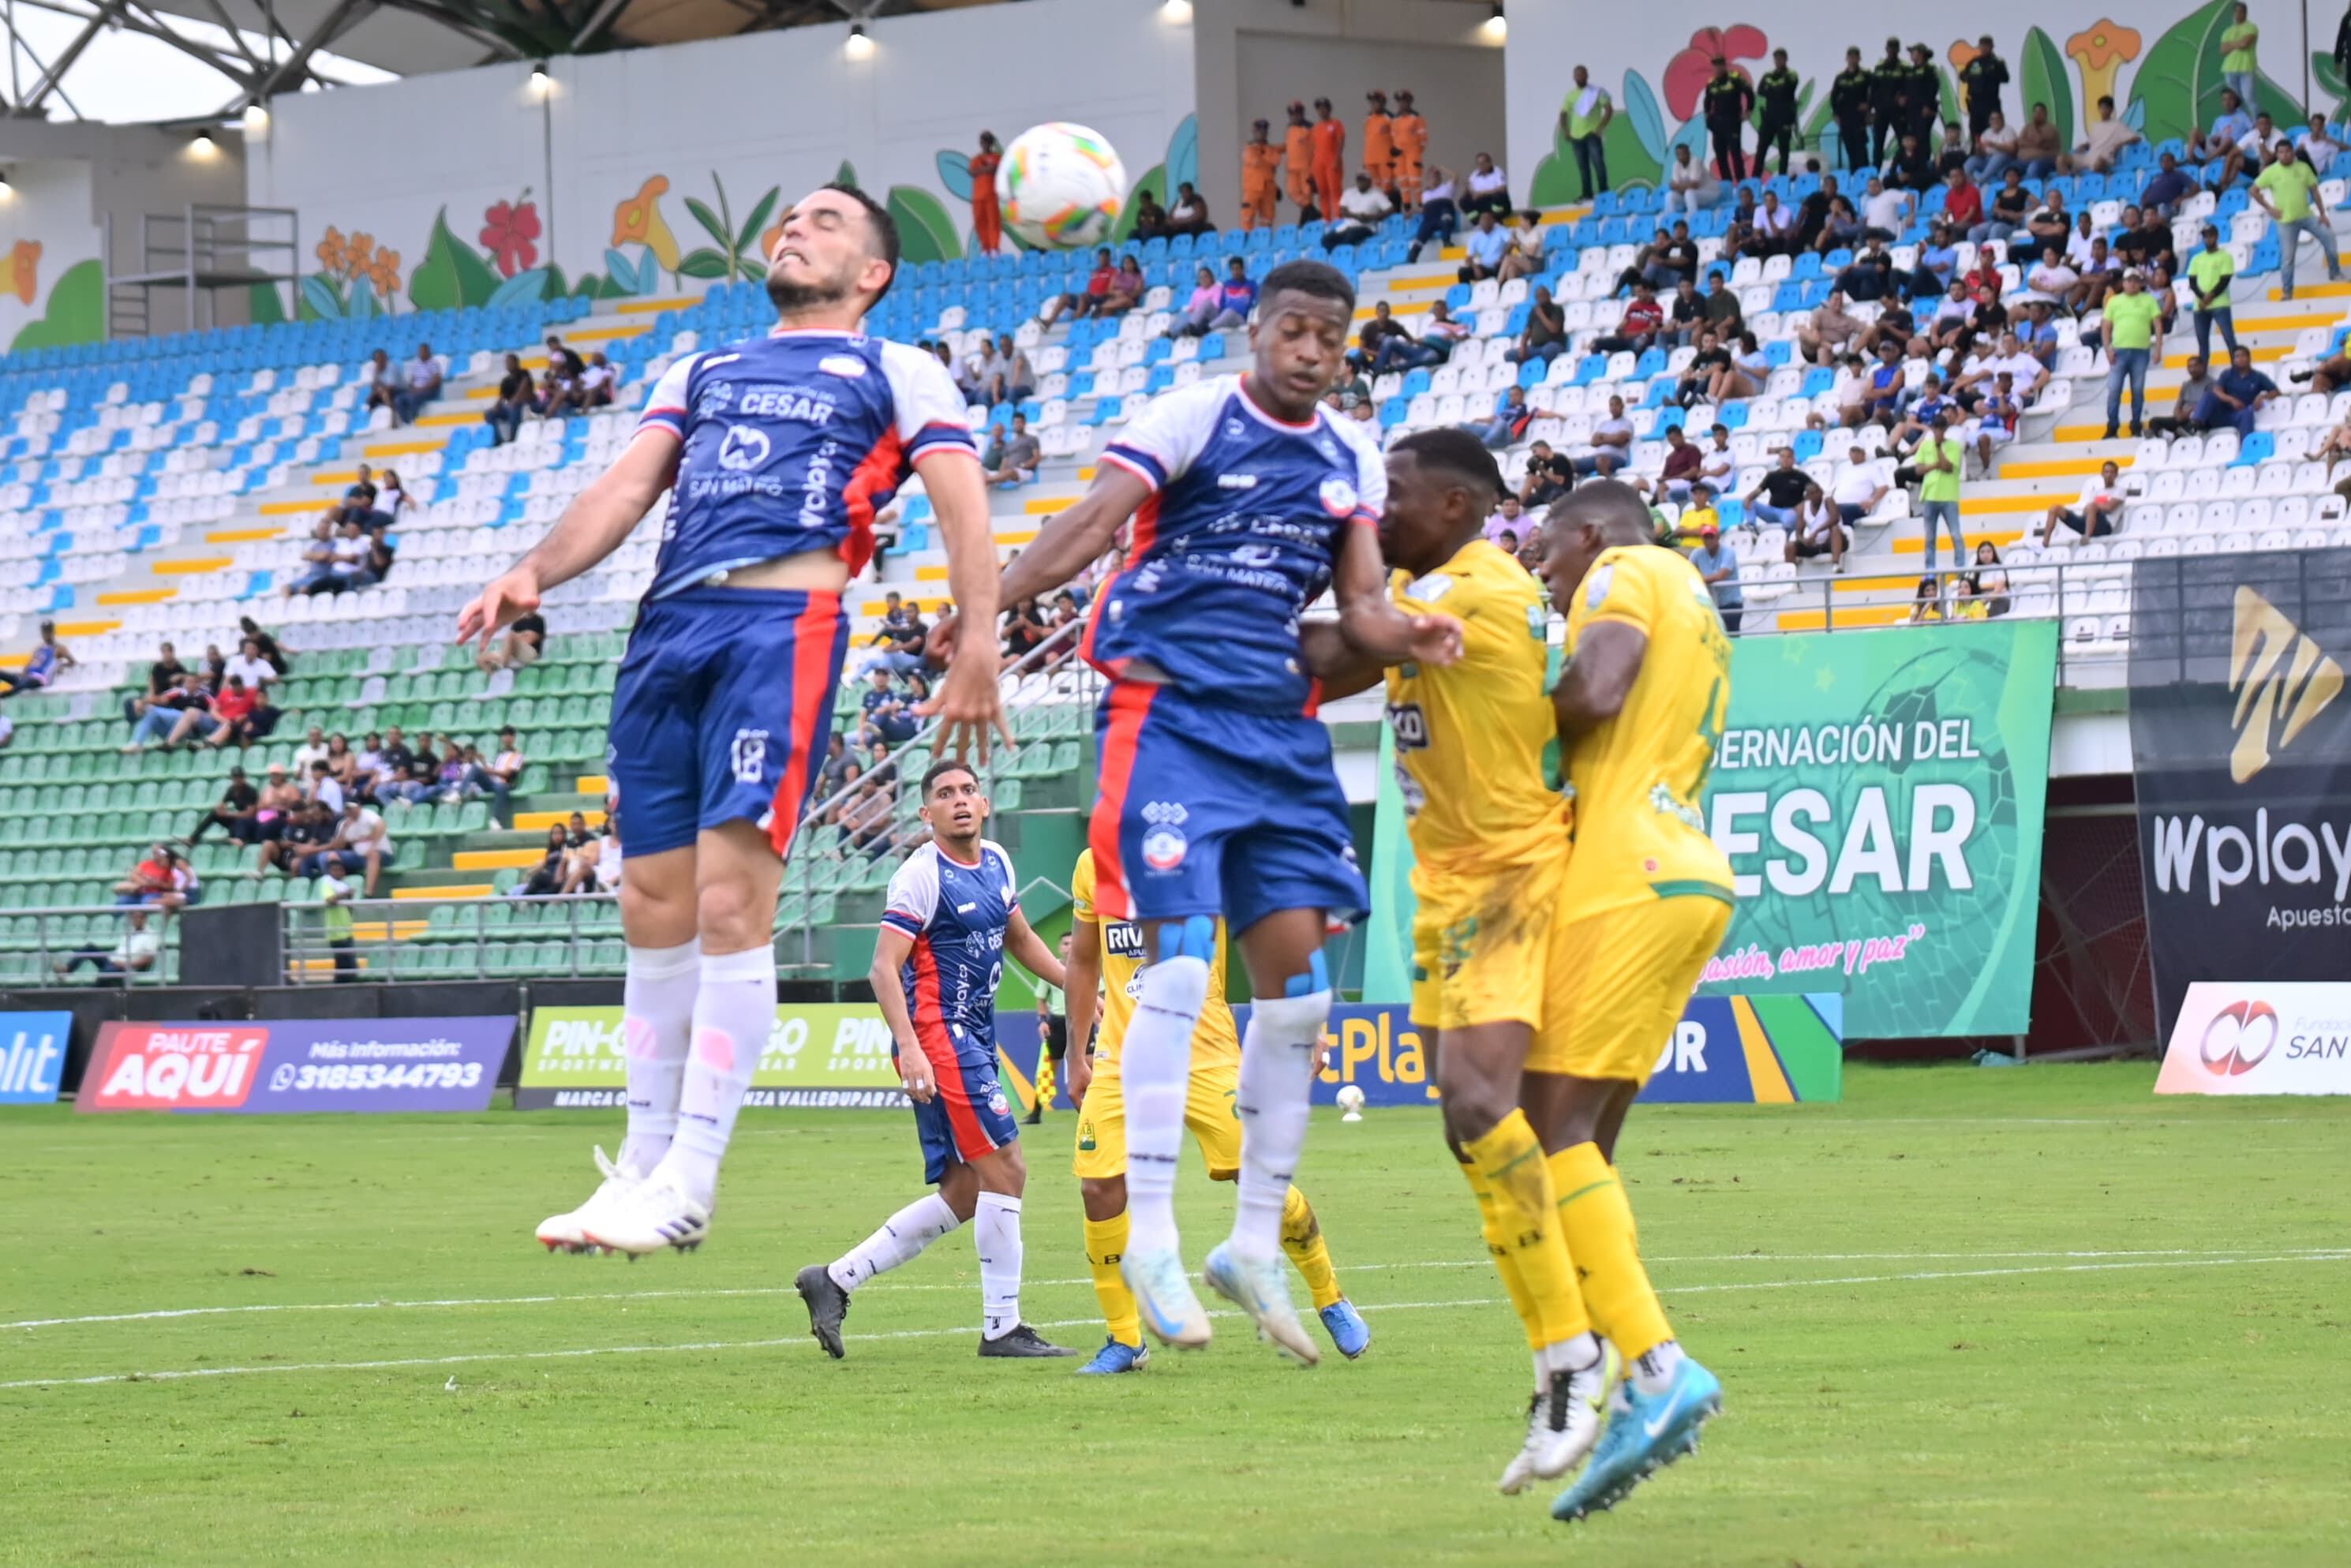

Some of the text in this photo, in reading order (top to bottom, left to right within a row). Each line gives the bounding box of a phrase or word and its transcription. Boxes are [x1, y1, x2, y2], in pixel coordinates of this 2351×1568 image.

[740, 393, 834, 427] CESAR
[1709, 715, 1980, 770] ERNACIÓN DEL
[1709, 783, 1975, 897] ESAR
[2154, 806, 2351, 906] Wplay
[1779, 941, 1845, 973] amor
[1844, 940, 1862, 976] y
[148, 1032, 232, 1053] PAUTE
[308, 1039, 348, 1059] Más
[1319, 1012, 1441, 1098] tPla
[2285, 1035, 2349, 1060] SAN
[0, 1031, 58, 1094] lit
[101, 1039, 261, 1101] AQUÍ
[294, 1061, 483, 1091] 3185344793
[554, 1091, 614, 1106] MARCA
